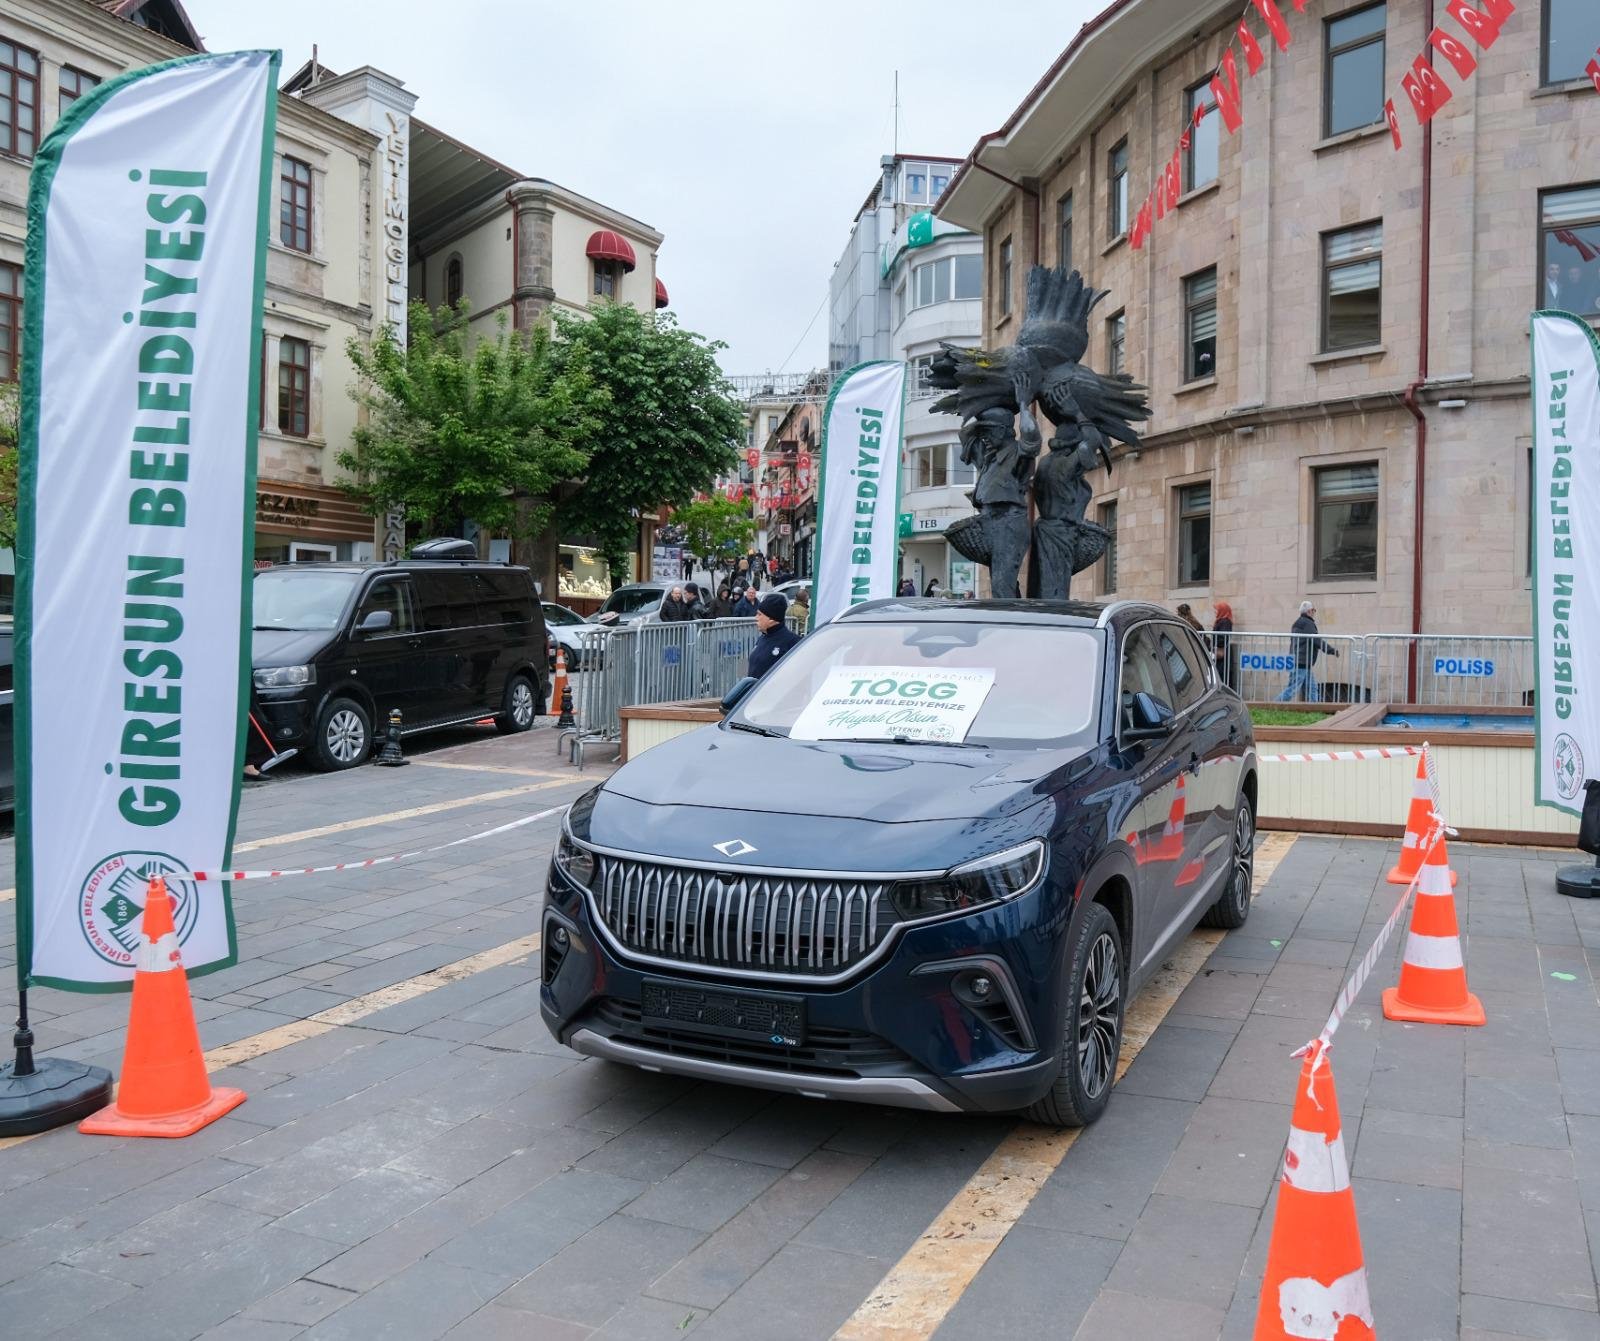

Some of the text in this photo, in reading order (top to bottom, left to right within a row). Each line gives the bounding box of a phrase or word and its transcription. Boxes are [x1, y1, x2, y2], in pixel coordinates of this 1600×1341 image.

[850, 407, 884, 565] BELEDİYESİ
[105, 169, 208, 827] GİRESUN BELEDİYESİ
[920, 520, 937, 529] TEB
[849, 678, 958, 700] TOGG
[117, 899, 128, 922] 1869
